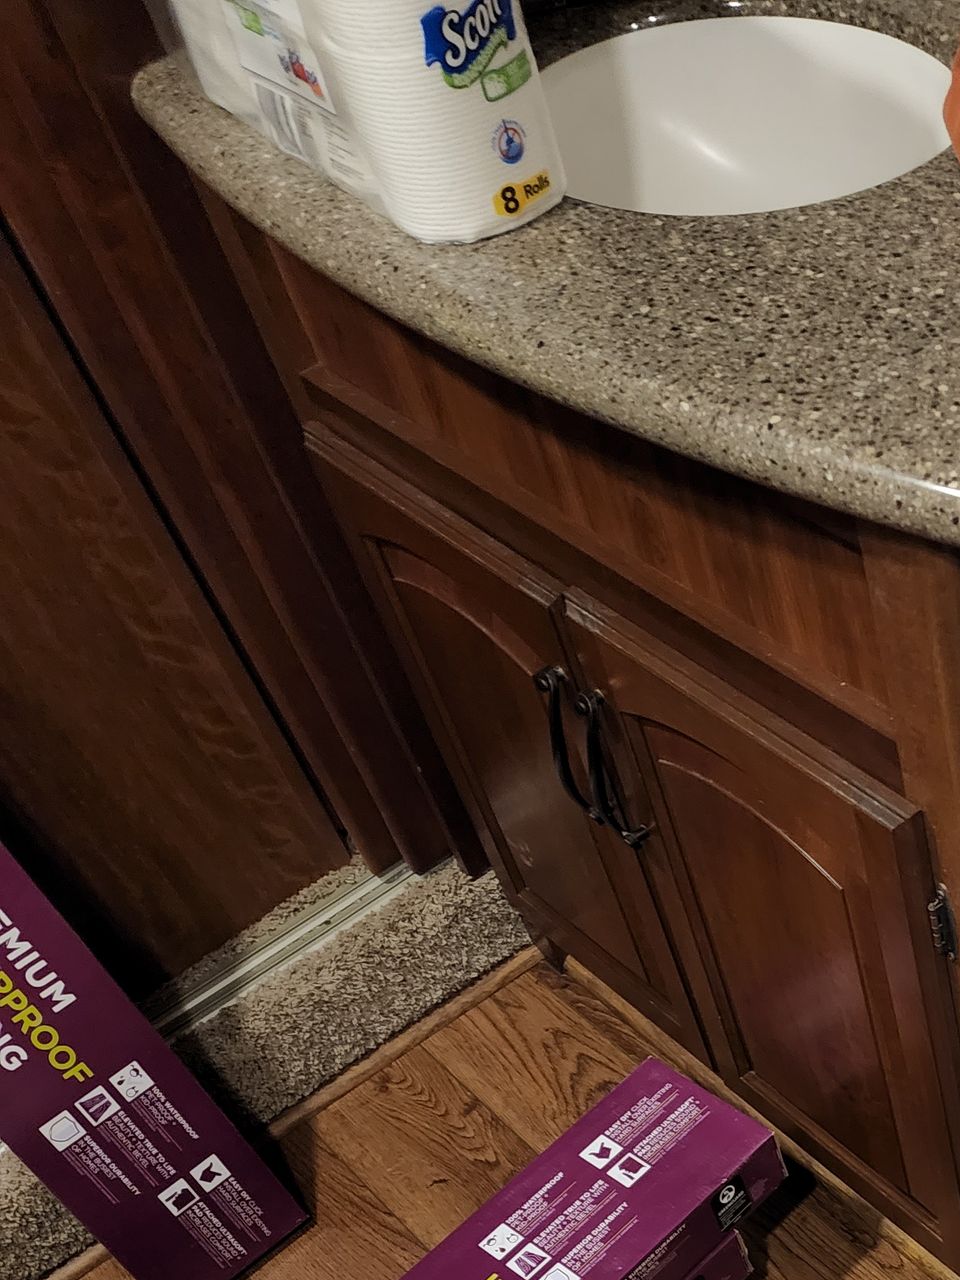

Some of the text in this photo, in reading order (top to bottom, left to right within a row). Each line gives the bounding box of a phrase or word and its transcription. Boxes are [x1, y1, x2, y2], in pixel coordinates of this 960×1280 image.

[501, 175, 550, 214] 8 Rolls
[139, 1094, 167, 1126] KID-PROOF
[145, 1090, 174, 1122] PET-PROOF
[151, 1085, 167, 1103] 100%
[163, 1099, 199, 1141] WATERPROOF
[630, 1103, 649, 1119] OVER
[104, 1118, 135, 1152] AUTHENTIC
[131, 1148, 150, 1168] BEVEL
[117, 1109, 176, 1176] ELEVATED TRUE TO LIFE
[604, 1119, 622, 1136] EASY
[631, 1125, 663, 1154] ATTACHED
[70, 1143, 99, 1174] OF HOMES
[76, 1138, 86, 1148] IN
[83, 1145, 97, 1159] THE
[111, 1114, 133, 1138] BEAUTY
[134, 1140, 158, 1167] TEXTURE
[154, 1163, 170, 1180] WITH
[637, 1144, 651, 1157] PAD
[82, 1133, 112, 1166] SUPERIOR
[108, 1161, 141, 1197] DURABILITY
[228, 1176, 243, 1192] EASY
[240, 1190, 251, 1201] DIY
[504, 1207, 524, 1225] 100%
[521, 1170, 565, 1210] WATERPROOF
[191, 1204, 203, 1217] PAD
[196, 1200, 222, 1228] ATTACHED
[239, 1199, 254, 1216] OVER
[510, 1196, 545, 1228] PET-PROOF
[515, 1200, 549, 1231] KID-PROOF
[532, 1178, 604, 1244] ELEVATED TRUE TO LIFE
[538, 1224, 563, 1247] BEAUTY
[566, 1196, 594, 1221] TEXTURE
[591, 1182, 609, 1198] WITH
[543, 1219, 578, 1251] AUTHENTIC
[575, 1202, 596, 1221] BEVEL
[560, 1234, 594, 1264] SUPERIOR
[590, 1201, 629, 1236] DURABILITY
[566, 1259, 576, 1267] IN
[573, 1248, 587, 1260] THE
[571, 1241, 604, 1271] OF HOMES
